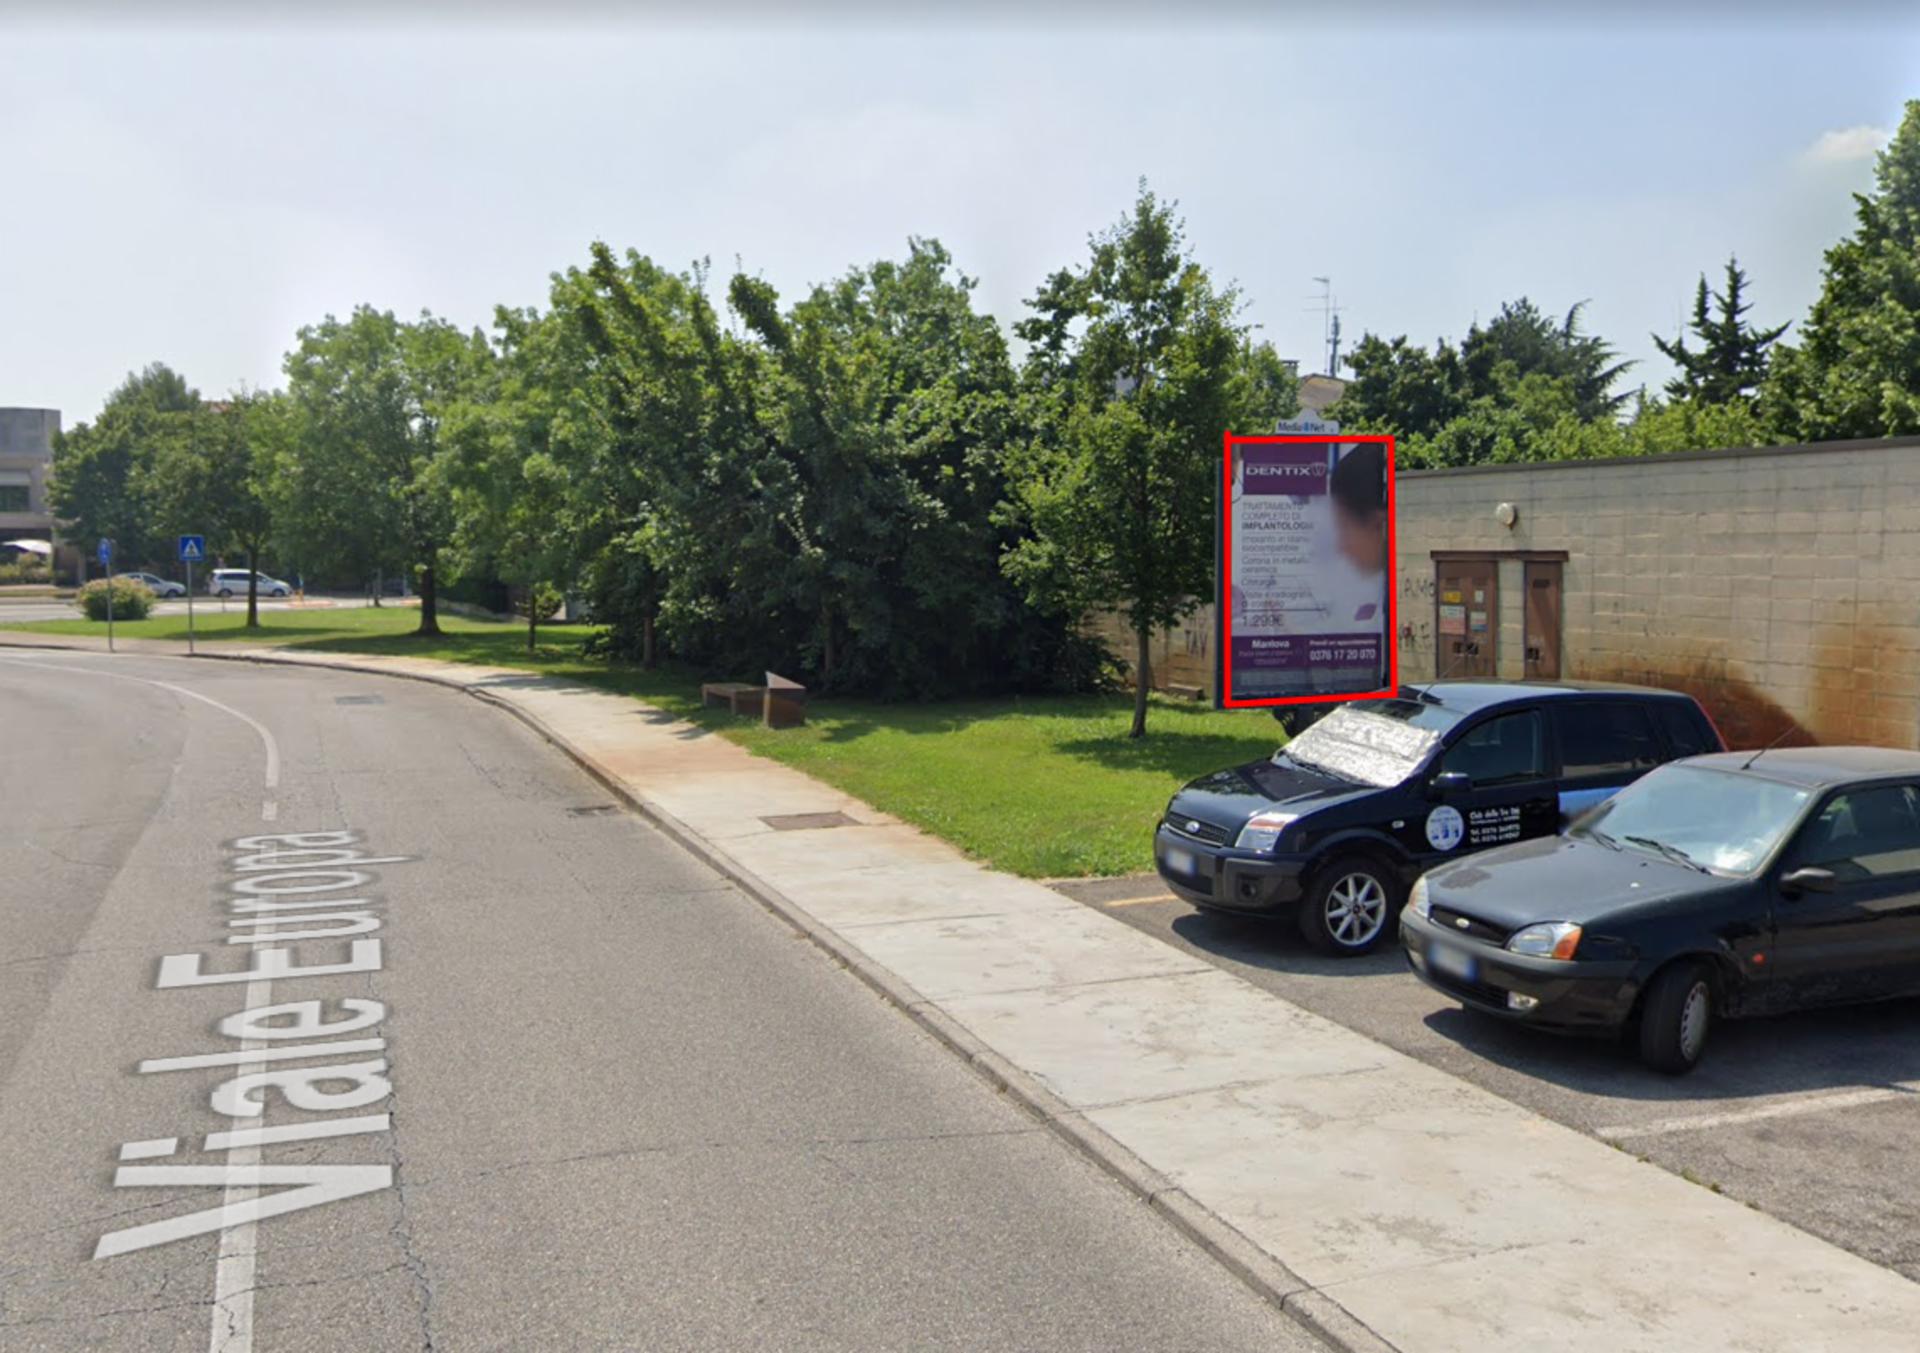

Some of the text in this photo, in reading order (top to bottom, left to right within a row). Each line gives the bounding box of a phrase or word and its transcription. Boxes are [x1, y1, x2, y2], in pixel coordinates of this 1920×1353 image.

[1246, 466, 1311, 476] DENTIX
[1243, 501, 1304, 510] TRATTAMENTO
[1242, 512, 1301, 520] COMPLETO DI
[1252, 639, 1290, 649] Mantova
[1310, 649, 1332, 661] 0376
[1334, 649, 1345, 660] 17
